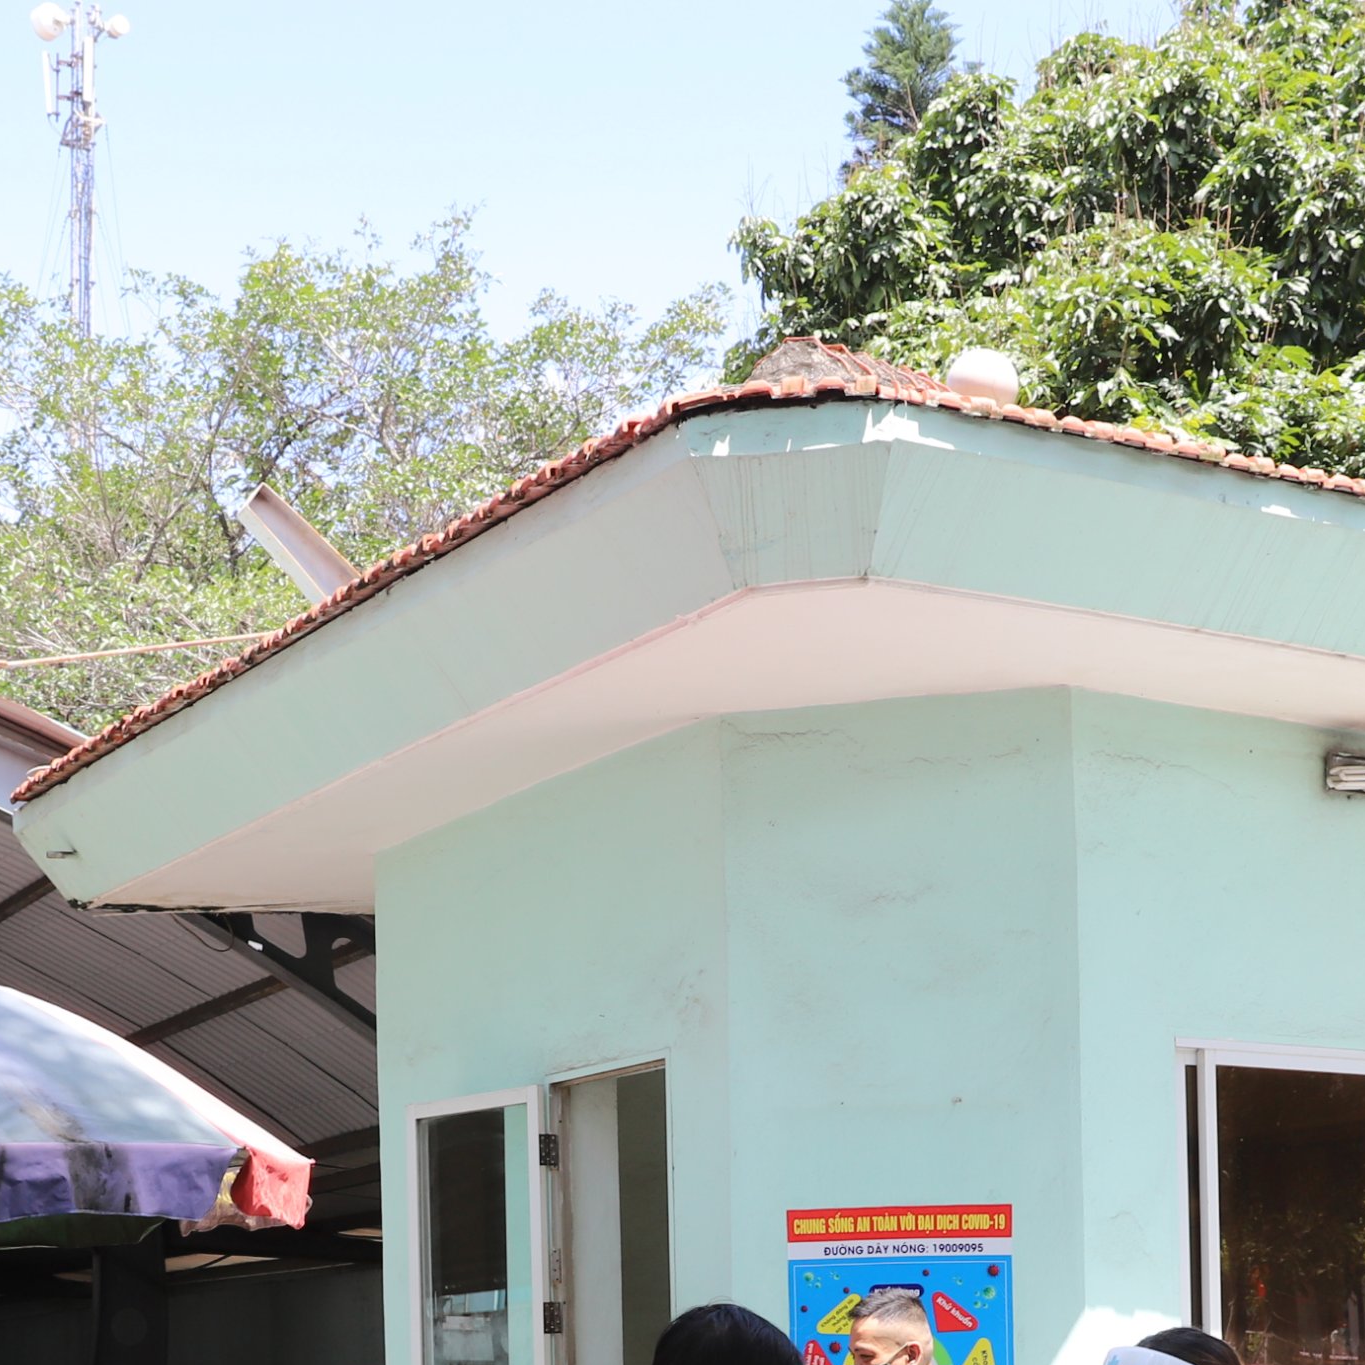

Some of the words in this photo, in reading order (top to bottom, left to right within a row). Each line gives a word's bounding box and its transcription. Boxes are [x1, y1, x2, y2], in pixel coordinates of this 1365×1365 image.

[794, 1218, 826, 1235] CHUNG
[828, 1212, 855, 1234] SỐNG
[856, 1216, 871, 1233] AN
[872, 1212, 898, 1232] TOÀN
[899, 1212, 916, 1232] VỚI
[917, 1214, 934, 1234] ĐẠI
[936, 1214, 960, 1234] DỊCH
[961, 1213, 1006, 1231] COVID-19
[823, 1243, 864, 1256] ĐƯỜNG
[867, 1242, 890, 1255] DÂY
[892, 1242, 929, 1254] NÓNG:
[932, 1243, 984, 1253] 19009095
